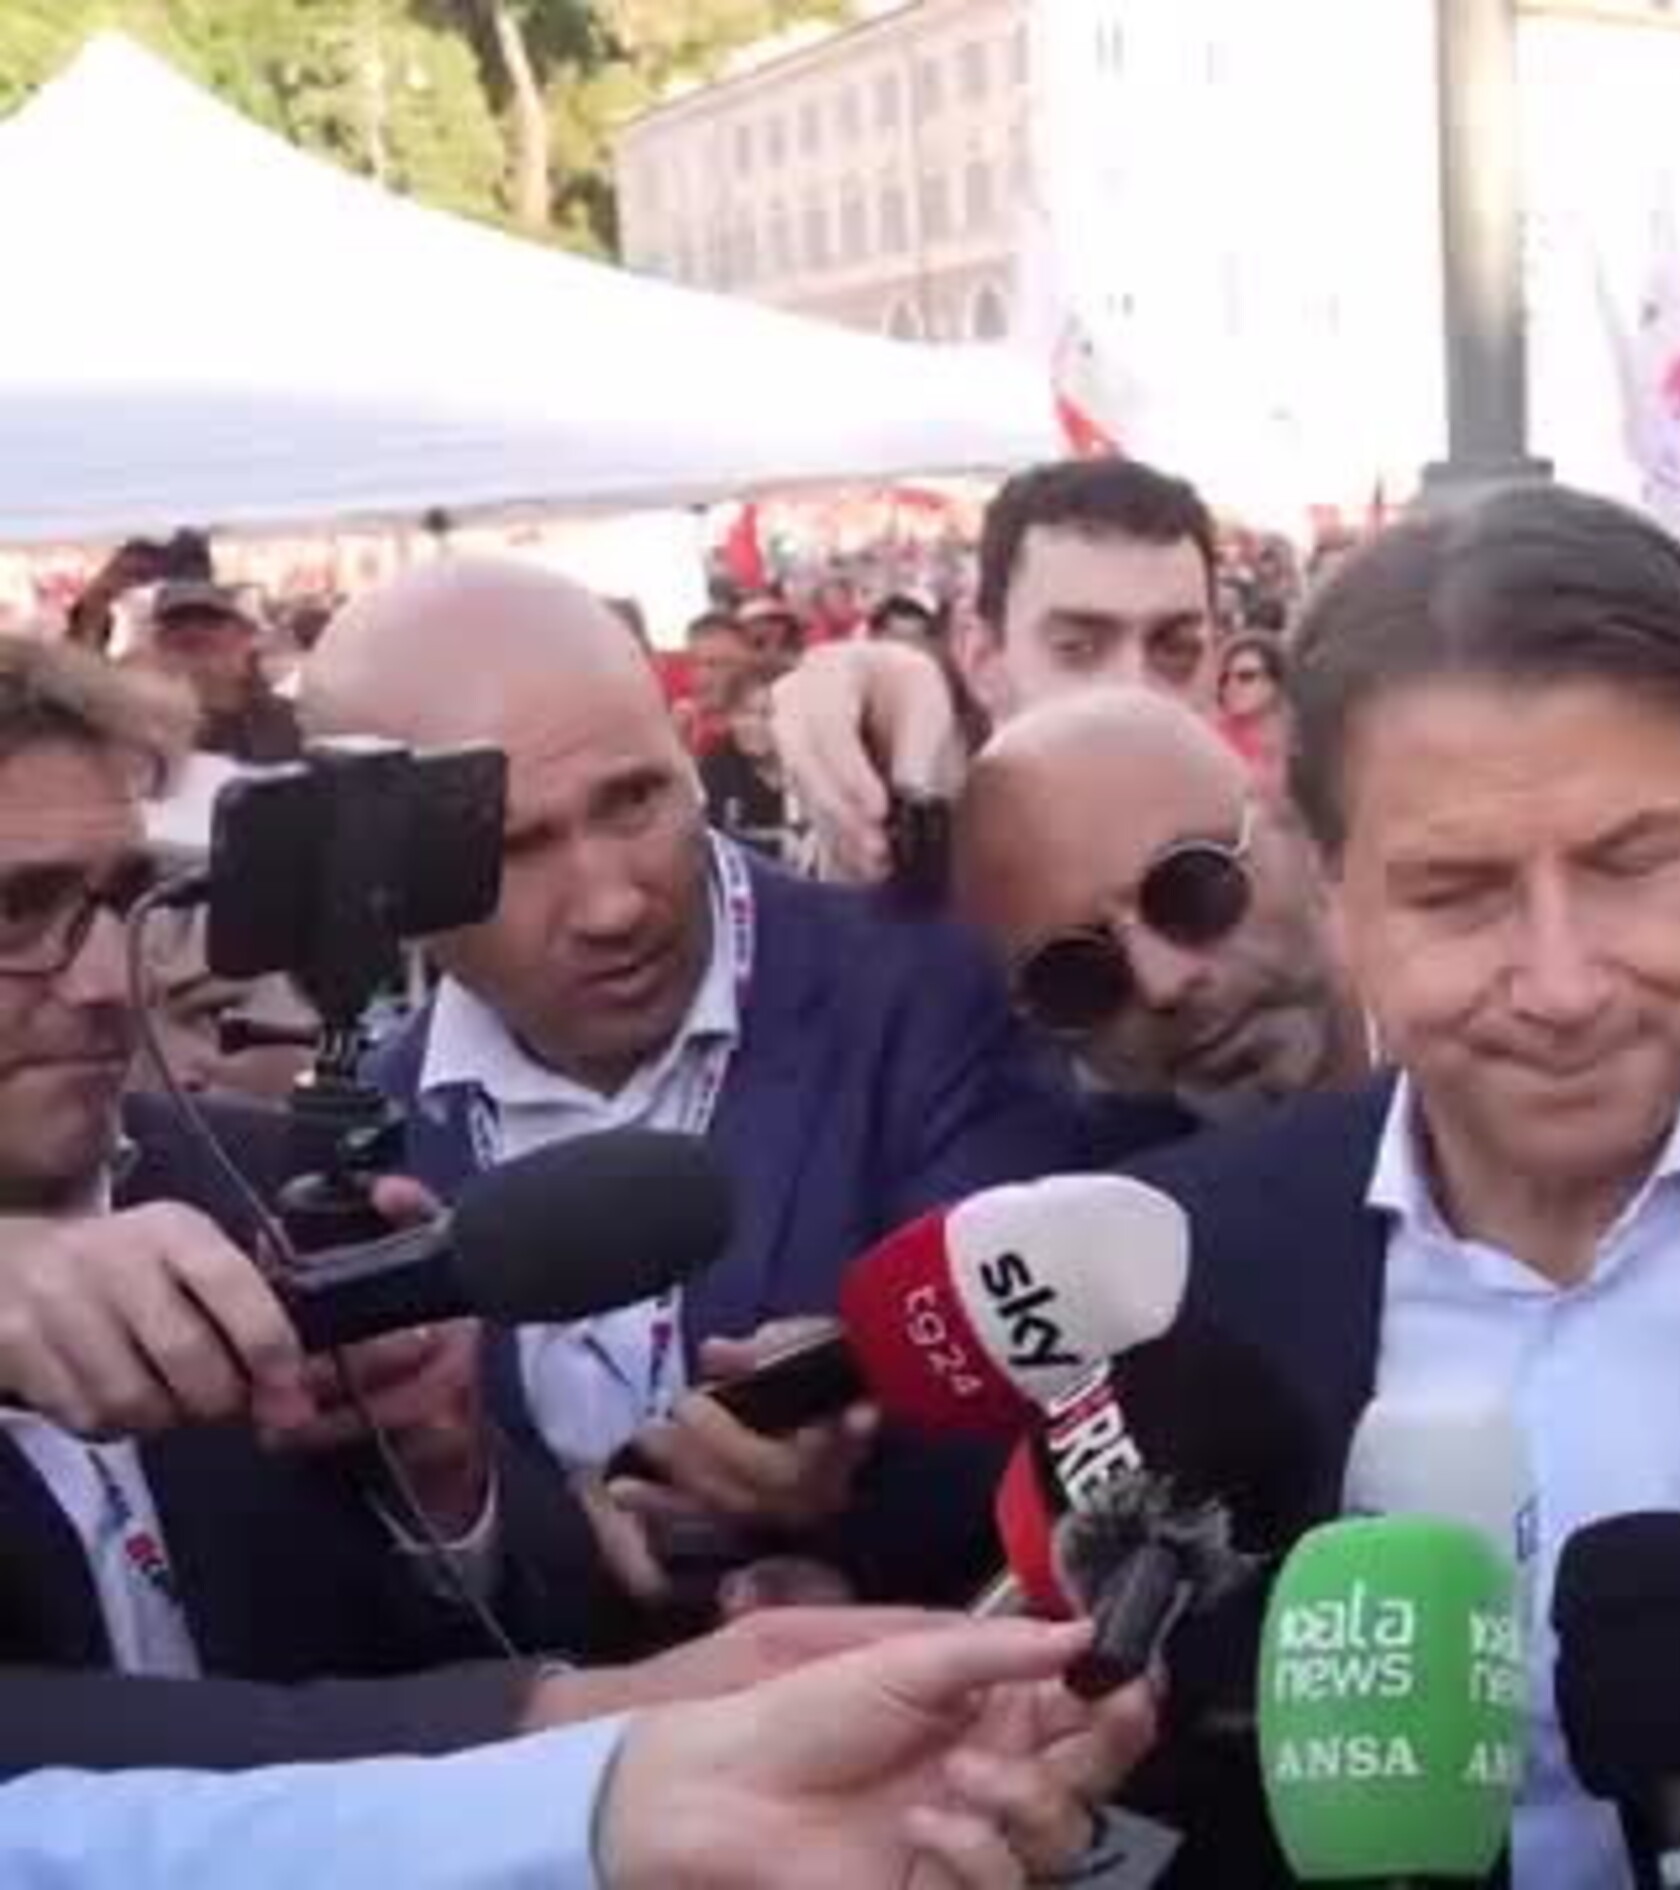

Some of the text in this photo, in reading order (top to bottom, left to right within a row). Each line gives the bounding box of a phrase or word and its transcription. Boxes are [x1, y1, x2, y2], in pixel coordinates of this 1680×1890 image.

[979, 1252, 1083, 1369] sky
[1275, 1652, 1414, 1703] news
[1274, 1734, 1422, 1781] ANSA
